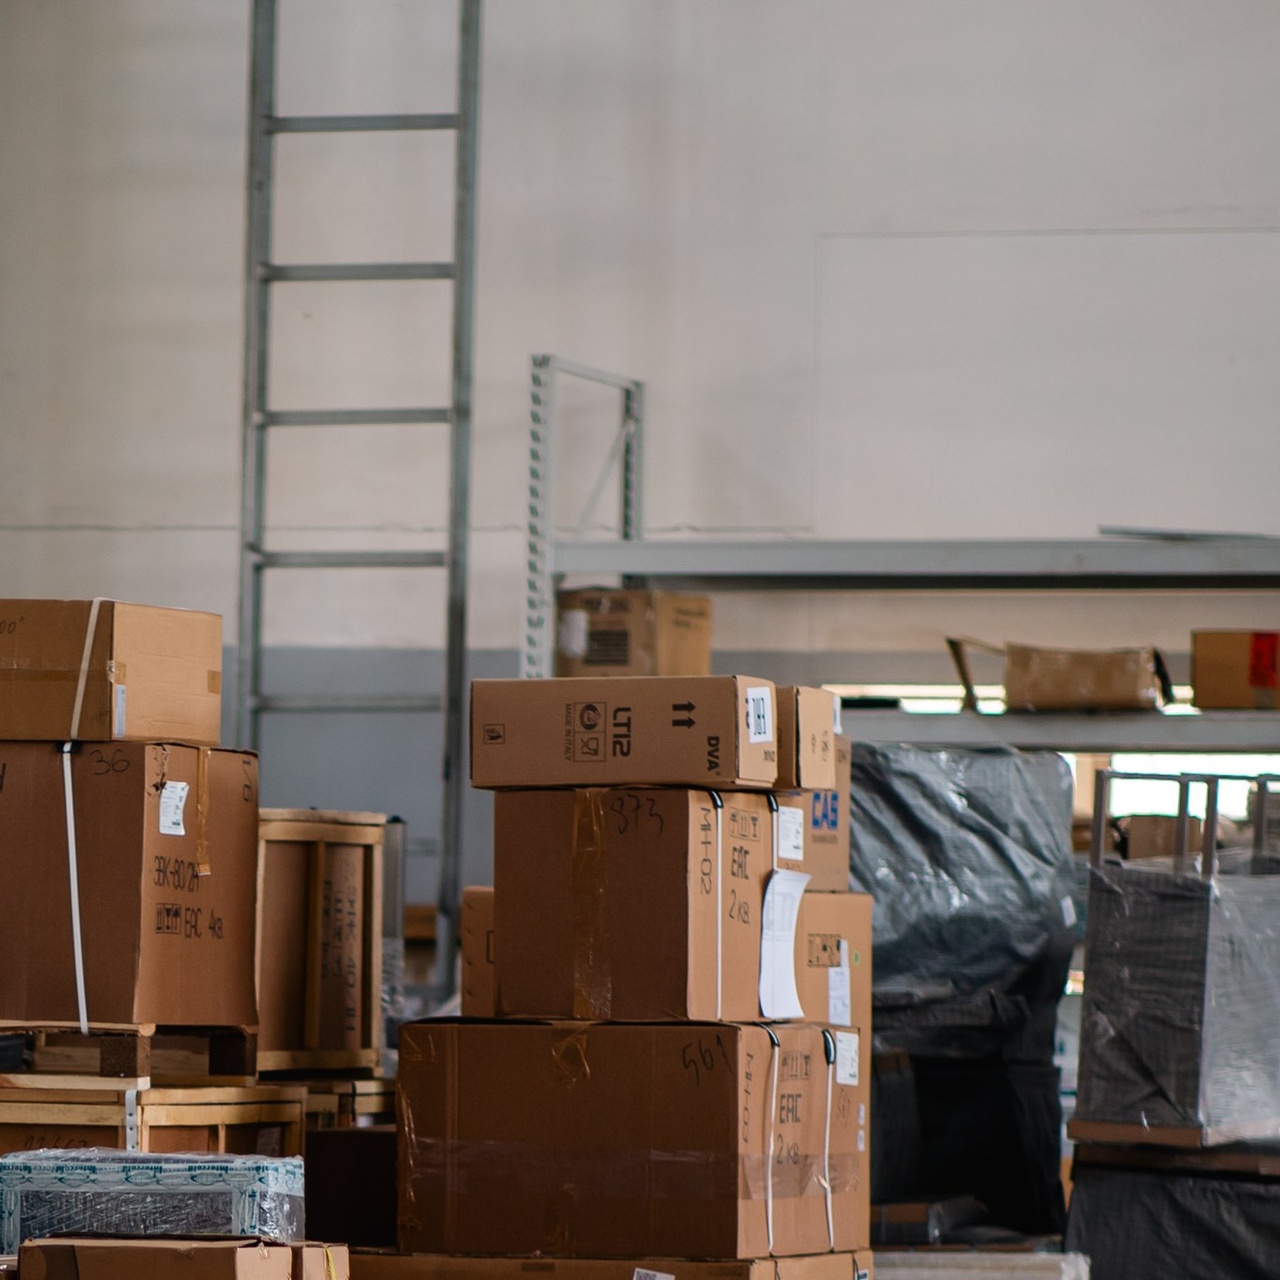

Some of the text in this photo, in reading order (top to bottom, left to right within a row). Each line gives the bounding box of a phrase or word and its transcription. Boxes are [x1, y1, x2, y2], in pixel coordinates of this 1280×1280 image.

[707, 735, 720, 772] DVA
[811, 791, 839, 830] CAS
[184, 907, 203, 939] EAC
[779, 1093, 803, 1125] EAC
